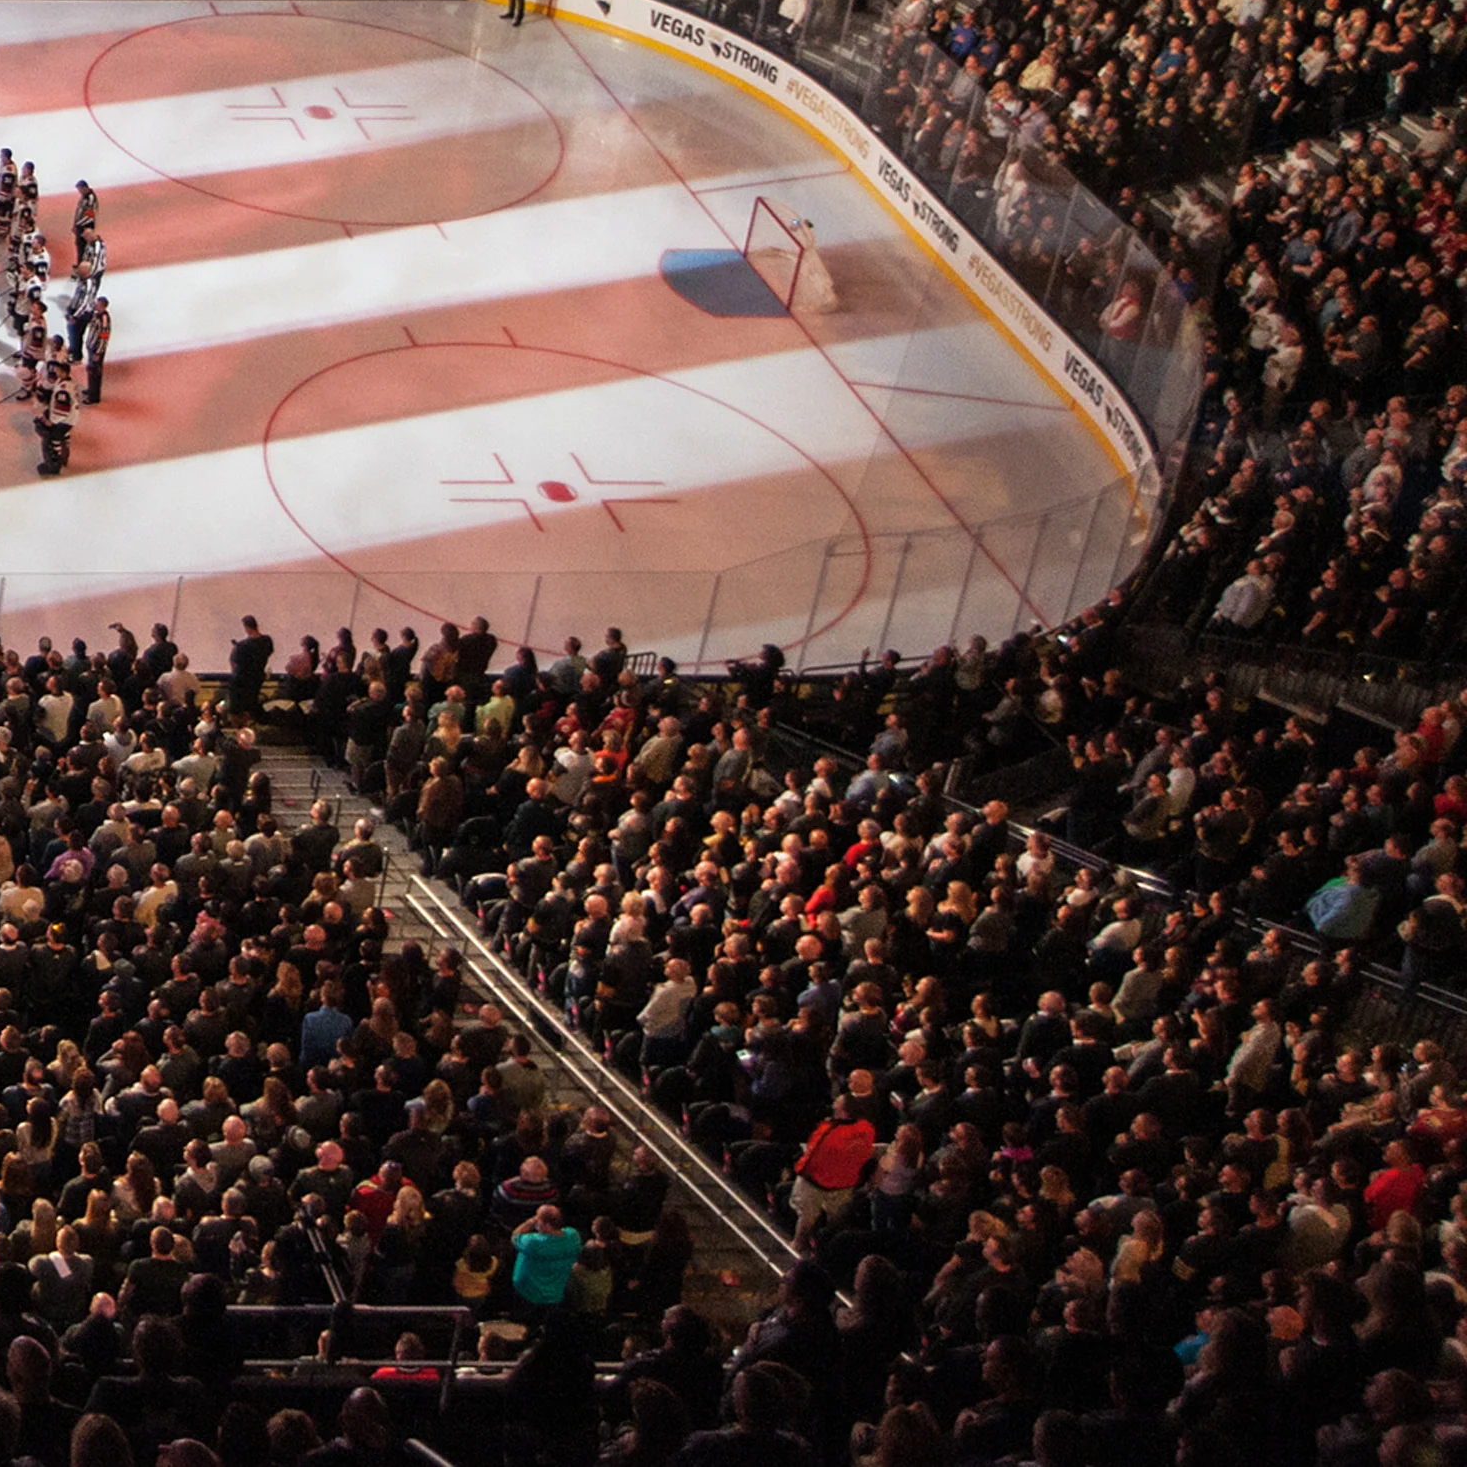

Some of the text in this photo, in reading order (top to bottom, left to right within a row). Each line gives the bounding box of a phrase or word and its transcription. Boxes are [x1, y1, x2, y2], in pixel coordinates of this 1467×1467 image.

[650, 9, 778, 85] VEGAS STRONG
[785, 76, 871, 160] #VEGASSTRONG
[877, 154, 960, 254] VEGAS STRONG
[1064, 350, 1105, 407] VEGAS
